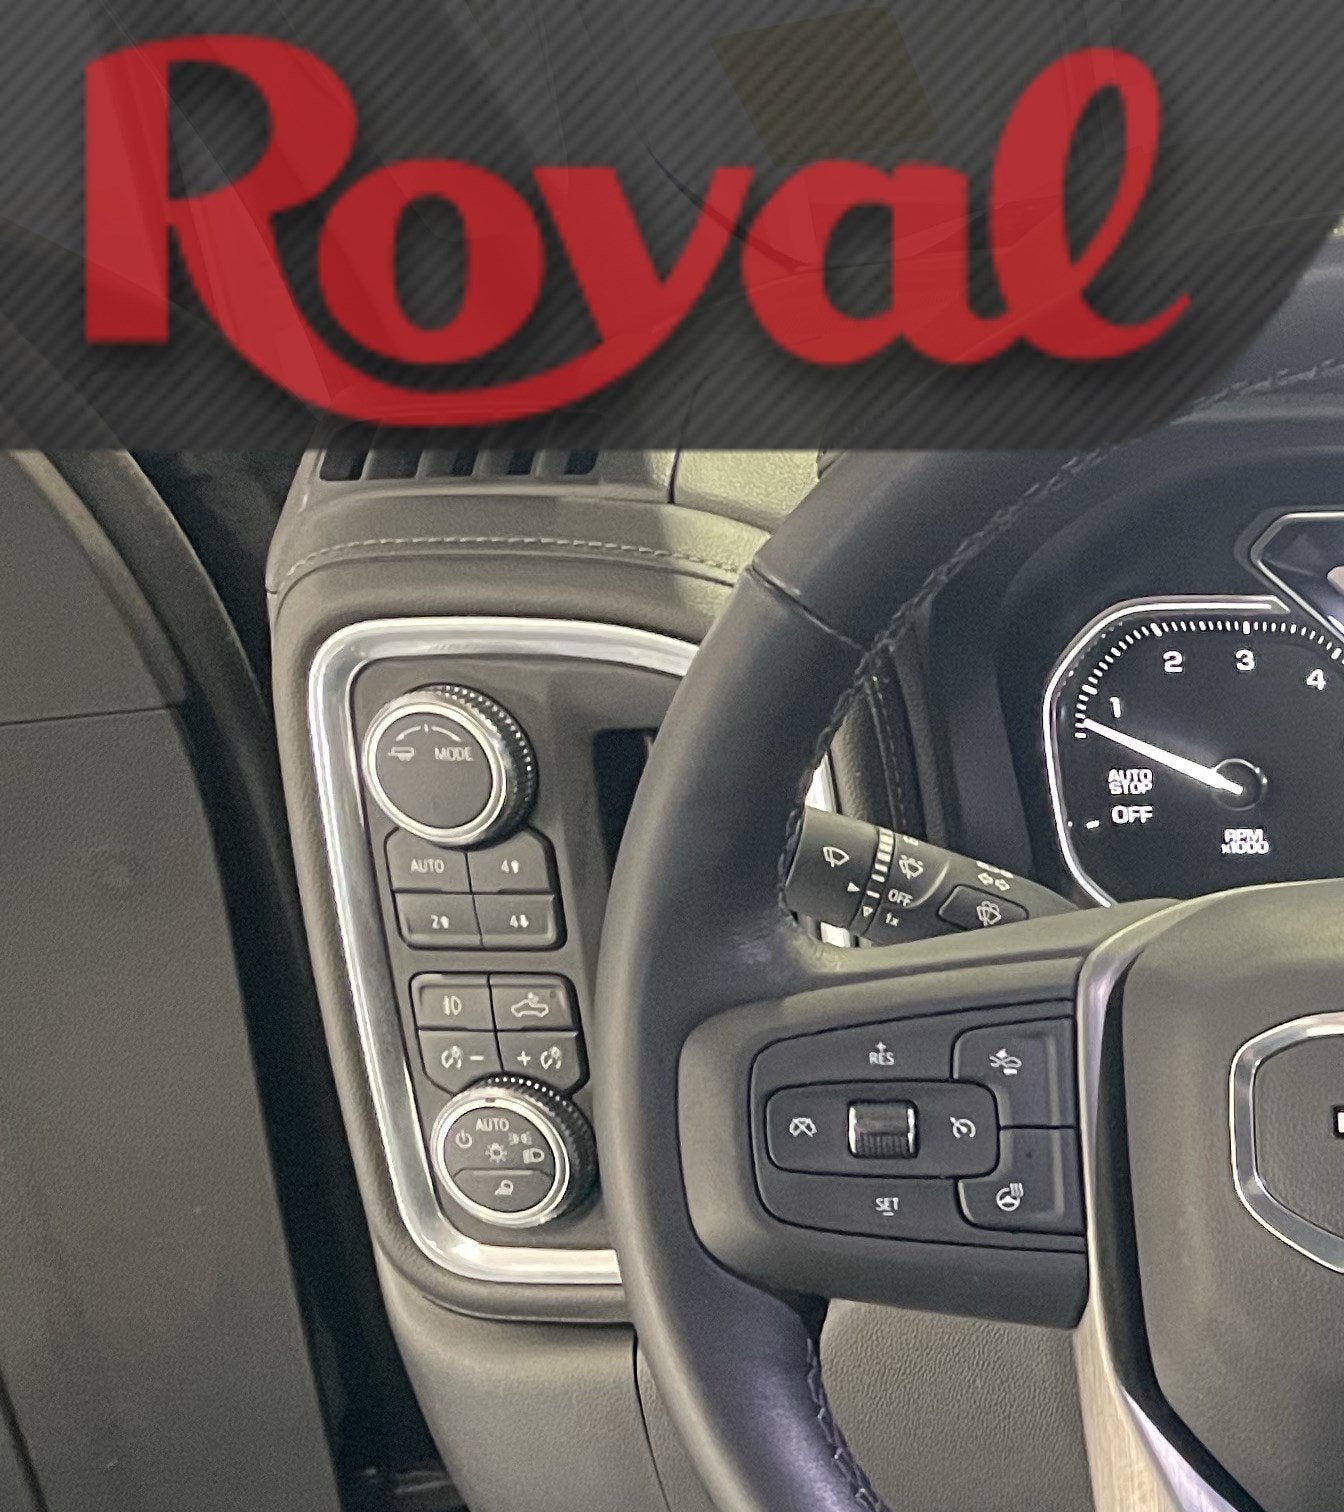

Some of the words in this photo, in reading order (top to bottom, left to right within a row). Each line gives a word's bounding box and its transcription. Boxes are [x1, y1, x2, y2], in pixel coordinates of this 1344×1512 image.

[1163, 650, 1184, 674] 2
[1235, 650, 1256, 672] 3
[1306, 670, 1326, 690] 4
[1110, 696, 1122, 718] 1
[434, 747, 474, 762] MODE
[1108, 769, 1153, 783] AUTO
[1109, 781, 1153, 795] STOP
[1111, 805, 1154, 824] OFF
[410, 858, 445, 873] AUTO
[888, 888, 914, 907] OFF
[869, 1050, 895, 1066] RES
[475, 1116, 510, 1132] AUTO
[875, 1197, 899, 1212] SET
